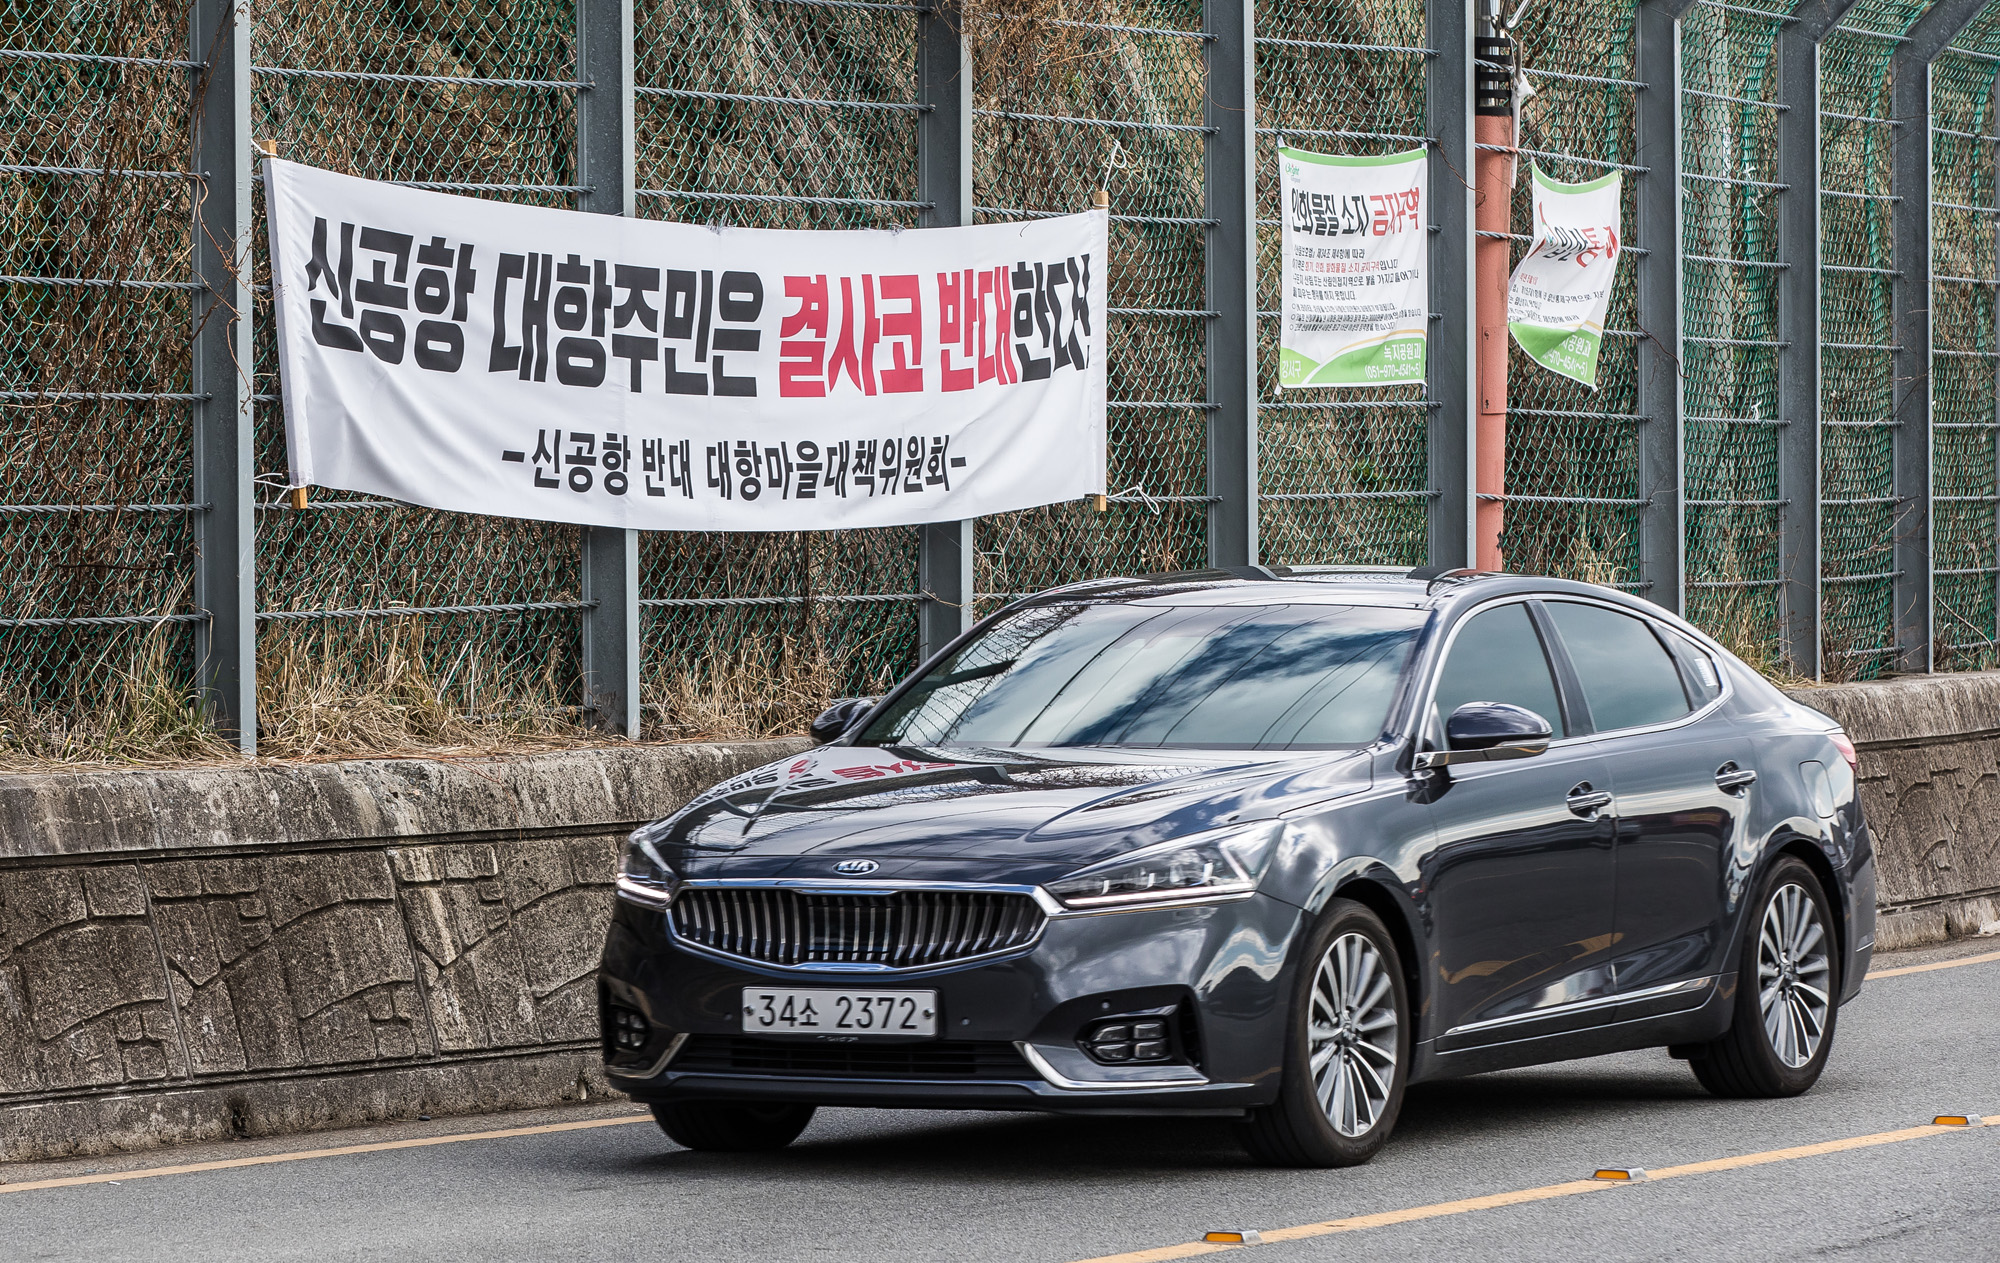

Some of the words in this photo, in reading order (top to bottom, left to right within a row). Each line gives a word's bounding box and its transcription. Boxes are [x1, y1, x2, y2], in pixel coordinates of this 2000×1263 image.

[1291, 187, 1339, 237] 인화물질
[1341, 194, 1370, 237] 소지
[1370, 187, 1420, 237] 금지구역
[304, 216, 477, 373] 신공항
[488, 251, 765, 397] 대항주민은
[779, 273, 924, 398] 결사코
[1282, 360, 1302, 379] 강서구
[1384, 343, 1422, 361] 녹지공원과
[641, 437, 694, 499] 반대
[758, 995, 819, 1028] 34소
[835, 996, 918, 1030] 2372
